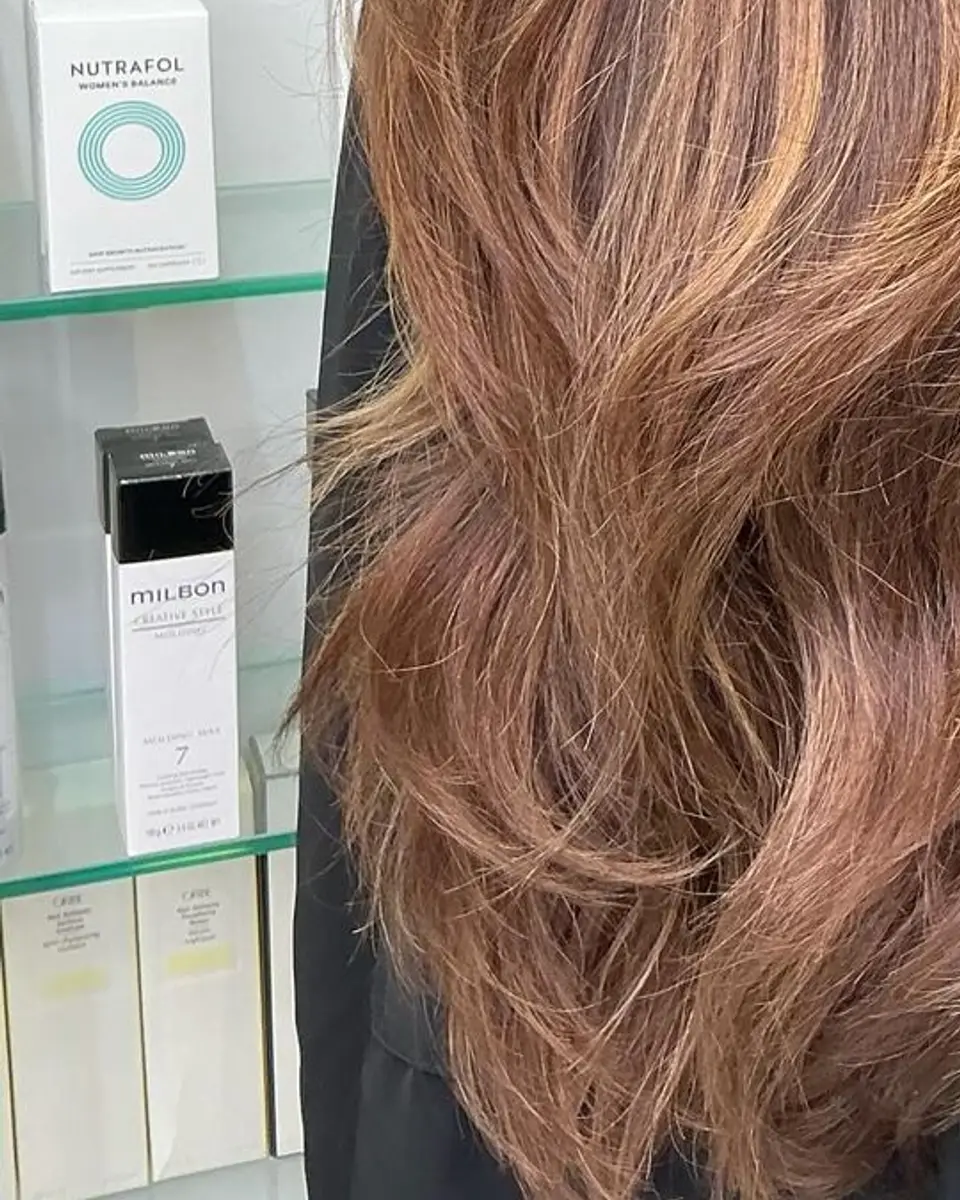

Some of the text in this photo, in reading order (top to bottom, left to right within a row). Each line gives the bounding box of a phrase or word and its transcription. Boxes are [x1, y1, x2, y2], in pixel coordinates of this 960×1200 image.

[71, 57, 184, 78] NUTRAFOL
[79, 76, 178, 90] WOMEN'S BALANCE
[174, 744, 190, 766] 7
